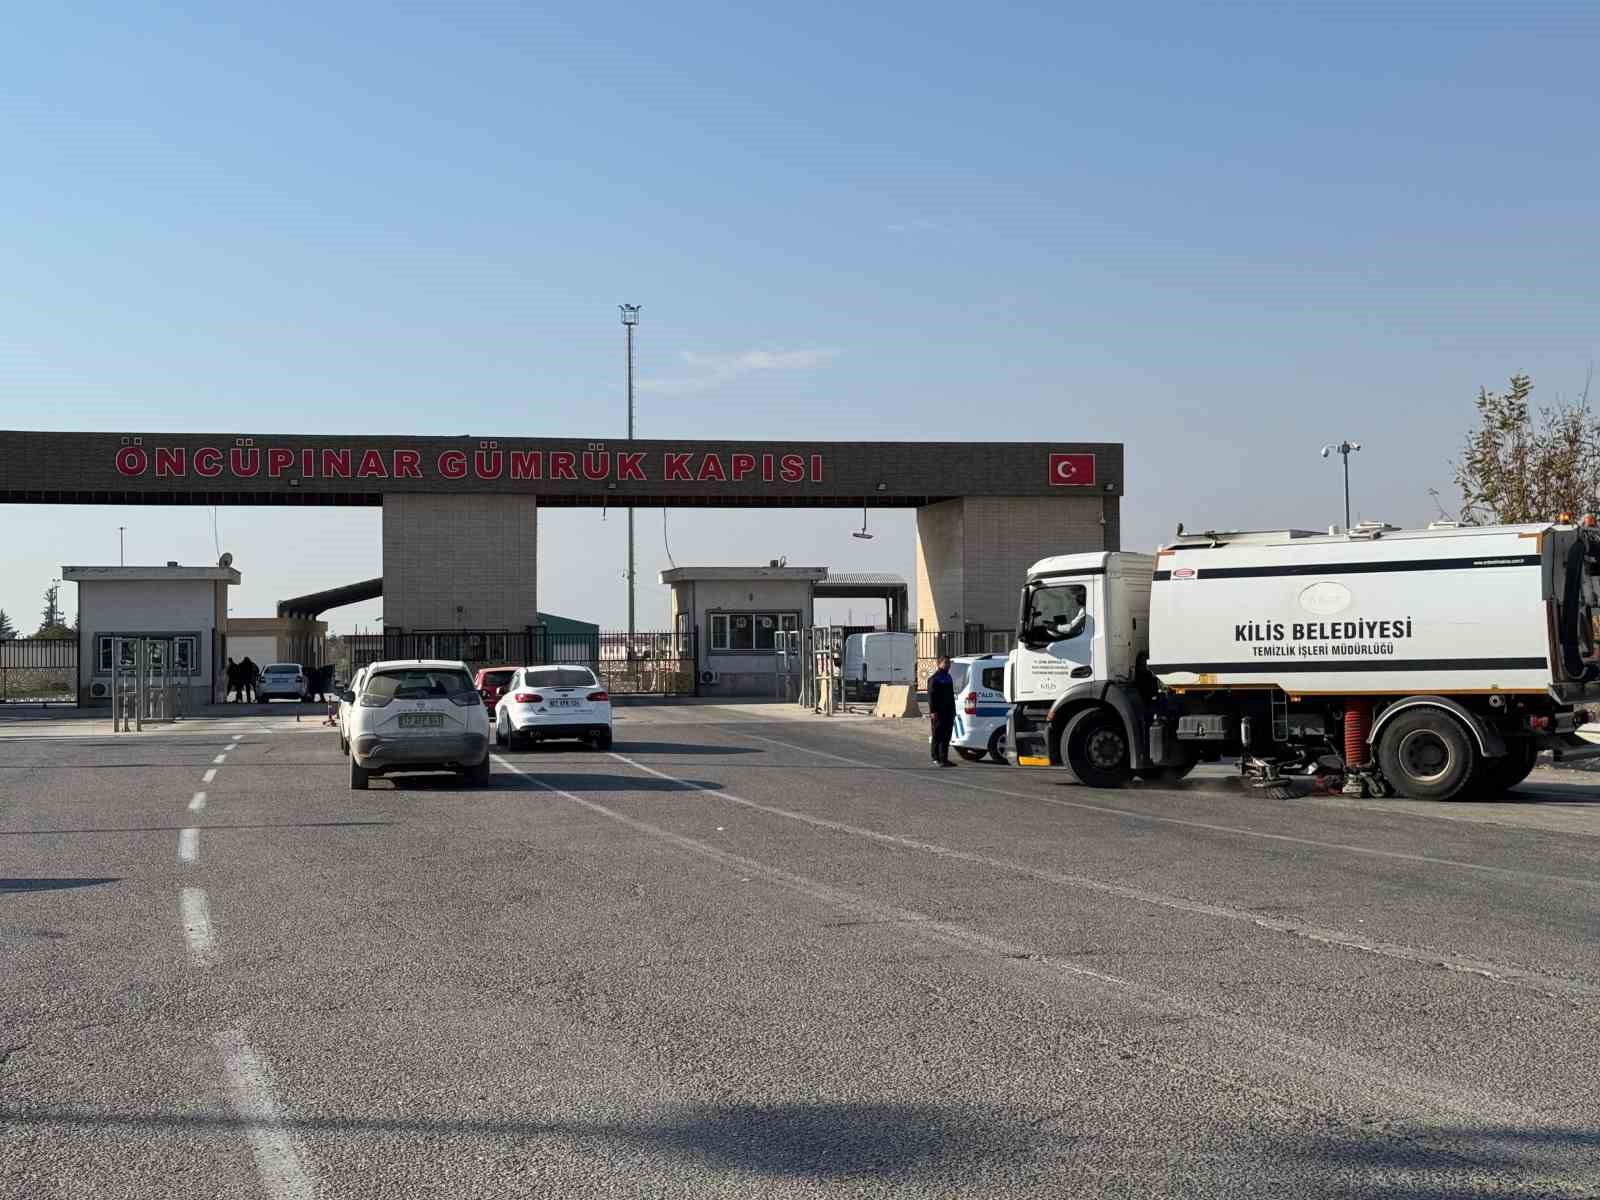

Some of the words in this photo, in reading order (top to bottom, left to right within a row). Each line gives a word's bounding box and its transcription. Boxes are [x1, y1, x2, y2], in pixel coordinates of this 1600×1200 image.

[115, 437, 424, 478] ÖNCÜPINAR
[437, 440, 648, 480] GÜMRÜK
[664, 452, 823, 482] KAPISI
[1235, 619, 1285, 641] KİLİS
[1292, 616, 1412, 640] BELEDİYESİ
[1252, 644, 1295, 657] TEMİZLİK
[1298, 643, 1328, 658] İŞLERİ
[1331, 642, 1394, 655] MÜDÜRLÜĞÜ
